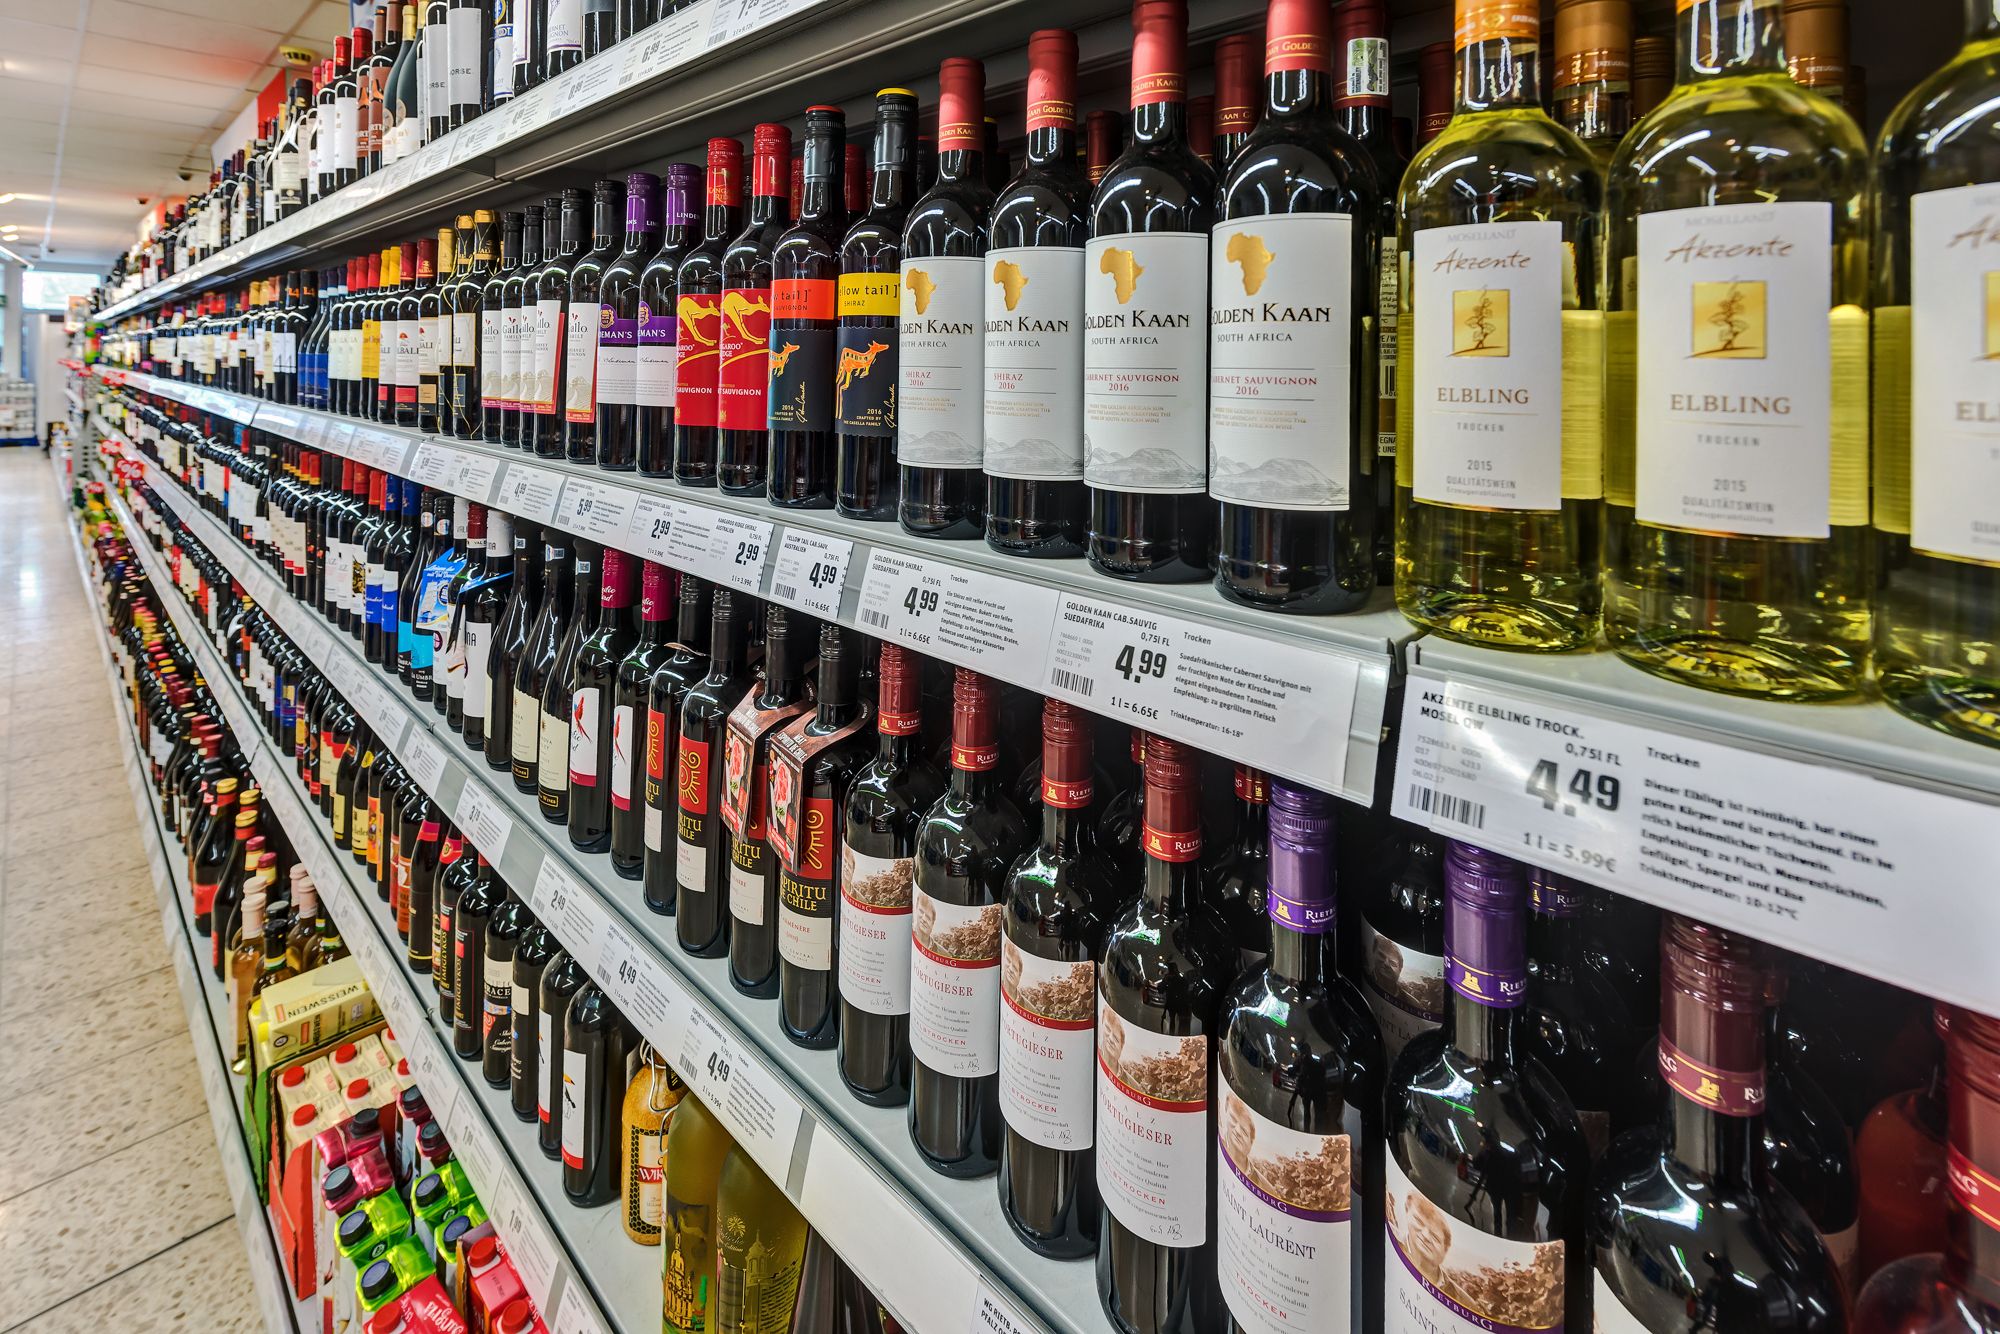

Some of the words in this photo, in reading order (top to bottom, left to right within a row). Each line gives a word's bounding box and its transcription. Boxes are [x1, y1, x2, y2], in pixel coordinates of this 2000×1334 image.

[1664, 234, 1795, 263] Akzente
[1433, 248, 1531, 274] Akzente
[1132, 310, 1190, 328] KAAN
[1262, 302, 1331, 322] KAAN
[927, 319, 973, 334] KAAN
[1018, 316, 1069, 332] KAAN
[1091, 337, 1116, 345] SOUTH
[1120, 336, 1159, 345] AFRICA
[1217, 333, 1244, 342] SOUTH
[1248, 333, 1293, 342] AFRICA
[993, 373, 1023, 381] SHIRAZ
[999, 382, 1015, 390] 2016
[1108, 383, 1129, 392] 2016
[1116, 374, 1179, 383] SAUVIGNON
[1244, 377, 1318, 386] SAUVIGNON
[1235, 386, 1259, 395] 2016
[1437, 387, 1529, 404] ELBLING
[1670, 394, 1791, 415] ELBLING
[1956, 401, 2000, 423] EL
[1457, 422, 1504, 432] TROCKEN
[1697, 434, 1760, 447] TROCKEN
[1467, 460, 1492, 471] 2015
[1713, 479, 1746, 492] 2015
[576, 498, 593, 516] 5.99
[651, 518, 671, 539] 2.99
[716, 524, 734, 534] AUSTRALIEN
[735, 541, 760, 566] 2.99
[784, 543, 807, 552] AUSTRALIEN
[872, 563, 900, 575] SUEDAFRIKA
[874, 554, 892, 564] GOLDEN
[905, 562, 923, 571] SHIRAZ
[809, 562, 837, 589] 4.99
[950, 574, 968, 584] Trocken
[815, 602, 830, 612] 6.65€
[904, 586, 939, 617] 4.99
[1064, 612, 1105, 629] SUEDAFRIKA
[1066, 601, 1092, 614] GOLDEN
[1093, 608, 1112, 619] KAAN
[1113, 613, 1157, 630] CAB.SAUVIG
[912, 632, 930, 644] 6.65€
[1162, 637, 1170, 646] FL
[1184, 632, 1211, 645] Trocken
[1115, 644, 1167, 683] 4.99
[1180, 652, 1232, 672] Suedafrikanischer
[1234, 667, 1261, 680] Cabernet
[1263, 675, 1298, 690] Sauvignon
[1300, 684, 1312, 693] mit
[1177, 664, 1187, 672] der
[1188, 667, 1219, 681] fruchtigen
[1220, 675, 1234, 685] Note
[1235, 680, 1246, 688] der
[1248, 683, 1271, 695] Kirsche
[1272, 691, 1286, 699] und
[1175, 676, 1197, 687] elegant
[1198, 682, 1245, 700] eingebundenen
[1246, 695, 1278, 710] Tanninen.
[1132, 703, 1158, 720] 6.65€
[1173, 687, 1210, 703] Empfehlung:
[1211, 697, 1218, 705] zu
[1219, 700, 1252, 715] gegrilltem
[1253, 710, 1276, 722] Fleisch
[1422, 691, 1475, 713] AKZENTE
[1478, 705, 1531, 726] ELBLING
[1535, 718, 1585, 739] TROCK.
[1170, 710, 1220, 732] Trinktemperatur:
[1420, 707, 1459, 726] MOSEL
[1565, 742, 1602, 761] 0,75l
[1606, 752, 1622, 767] FL
[1646, 746, 1701, 768] Trocken
[1525, 758, 1621, 818] 4.49
[1643, 777, 1680, 796] Dieser
[1684, 788, 1724, 810] Elbling
[1728, 799, 1744, 812] ist
[1815, 822, 1835, 836] hat
[1642, 796, 1676, 814] guten
[1679, 803, 1718, 824] Körper
[1722, 816, 1745, 831] und
[1748, 822, 1764, 835] ist
[1850, 850, 1874, 865] Ein
[1563, 844, 1617, 873] 5.99€
[1766, 844, 1835, 875] Tischwein.
[1696, 862, 1744, 885] Spargel
[1747, 878, 1770, 892] und
[550, 888, 566, 912] 2.49
[787, 895, 817, 912] CHILE
[921, 946, 957, 967] RIETBURG
[619, 959, 636, 984] 4.49
[288, 985, 358, 1018] WEISSWEIN
[1008, 998, 1045, 1026] RIETBURG
[707, 1051, 730, 1082] 4.49
[1108, 1071, 1151, 1106] RIETBURG
[1100, 1088, 1172, 1146] PORTUGIESER
[1235, 1167, 1288, 1212] RIETBURG
[1249, 1215, 1316, 1260] LAURENT
[1235, 1271, 1287, 1320] TROCKEN
[1421, 1277, 1493, 1332] RIETBURG
[981, 1310, 998, 1332] PFALZ
[984, 1298, 993, 1312] WG
[994, 1308, 1011, 1332] RIETB.
[1400, 1288, 1438, 1334] SAINT
